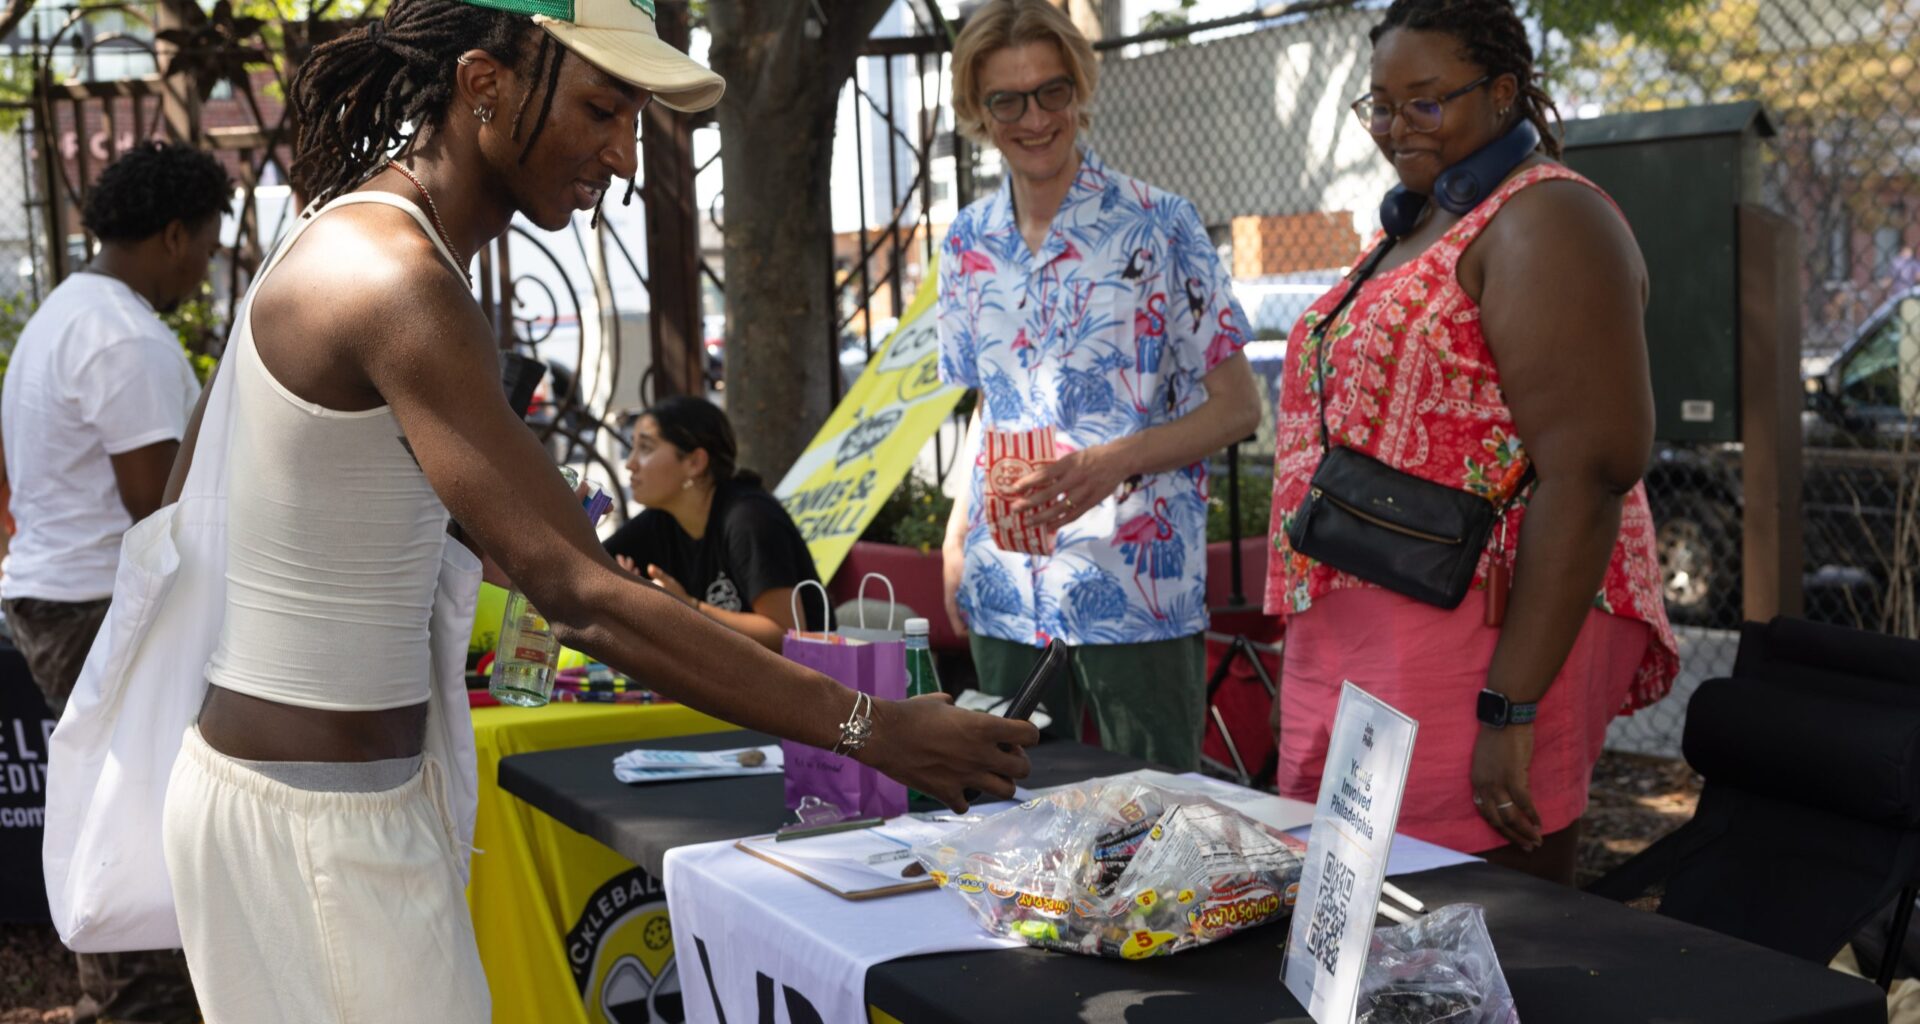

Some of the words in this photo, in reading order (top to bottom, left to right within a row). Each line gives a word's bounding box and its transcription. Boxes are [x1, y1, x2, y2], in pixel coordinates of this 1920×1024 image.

[890, 326, 938, 358] CO
[1341, 777, 1373, 812] Involved
[1330, 793, 1374, 841] Philadelphia
[570, 874, 666, 974] CKLEBAL
[1205, 904, 1238, 927] PLAY
[1135, 932, 1153, 948] 5
